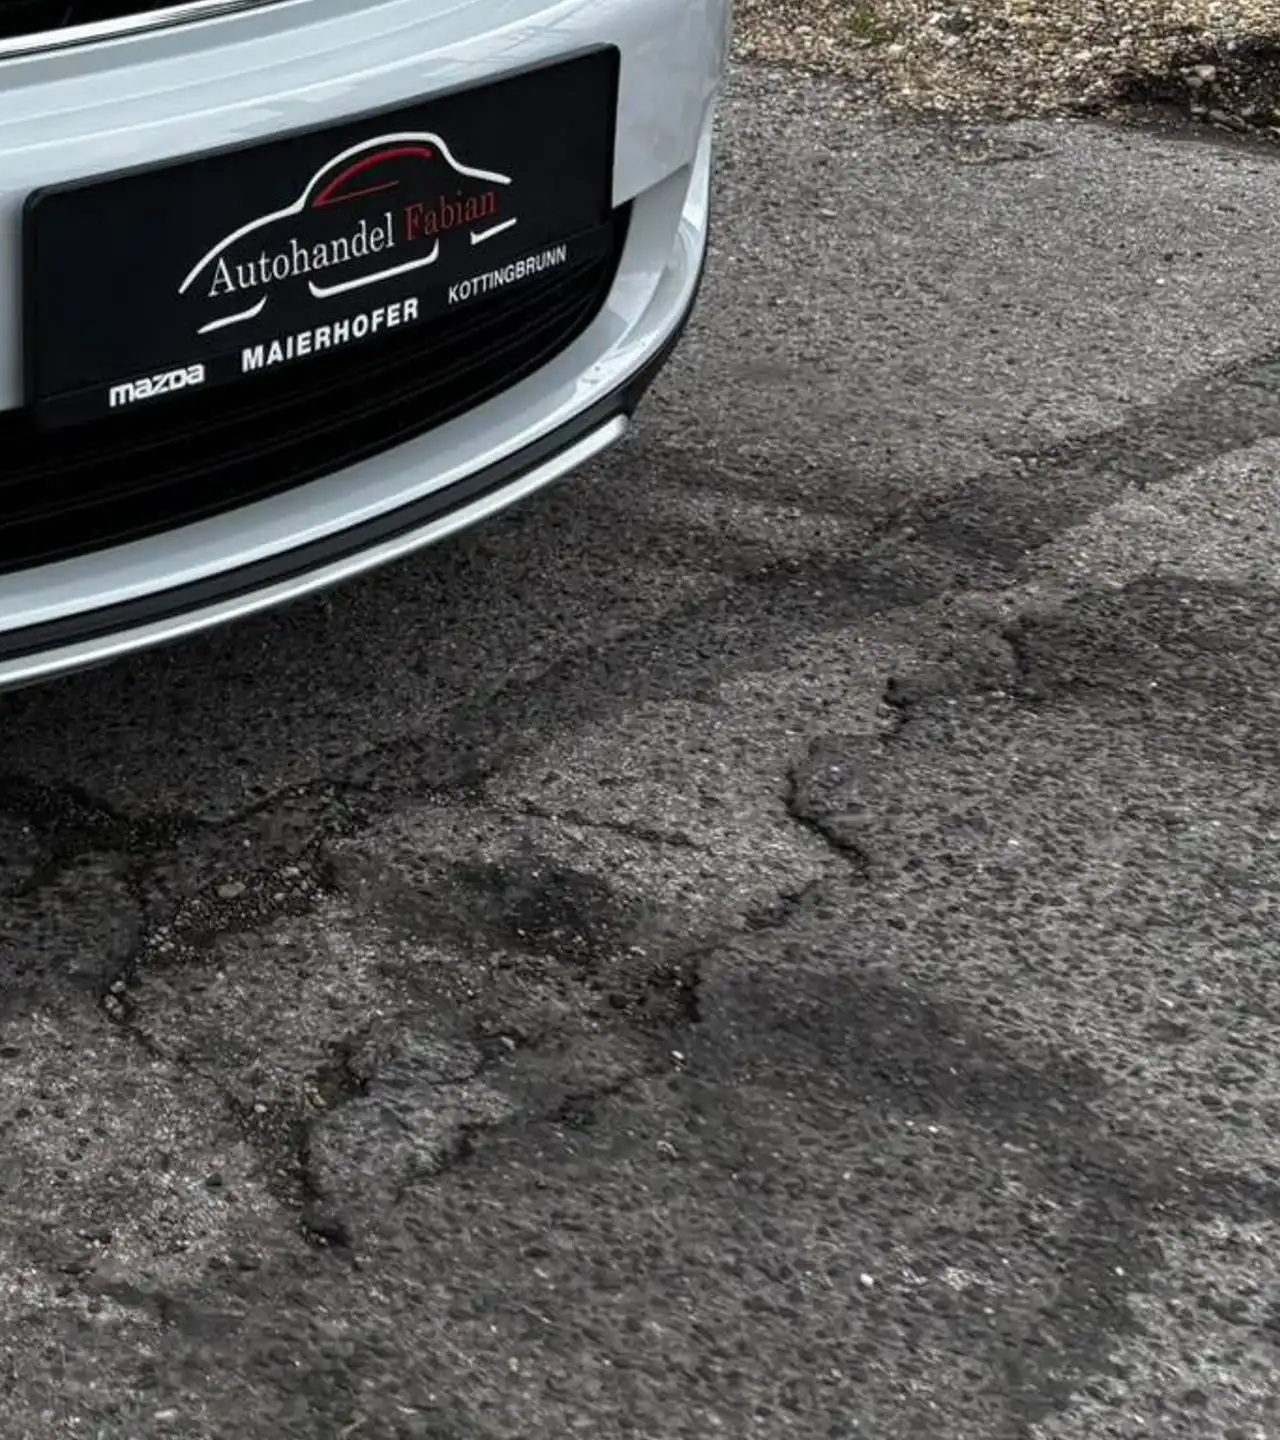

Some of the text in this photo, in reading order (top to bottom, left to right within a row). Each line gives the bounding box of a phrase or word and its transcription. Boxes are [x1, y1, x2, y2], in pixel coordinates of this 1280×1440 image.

[208, 188, 497, 297] Autohandel Fabian
[241, 297, 419, 373] MAIERHOFER
[448, 244, 568, 306] KOTTINGBRUNN
